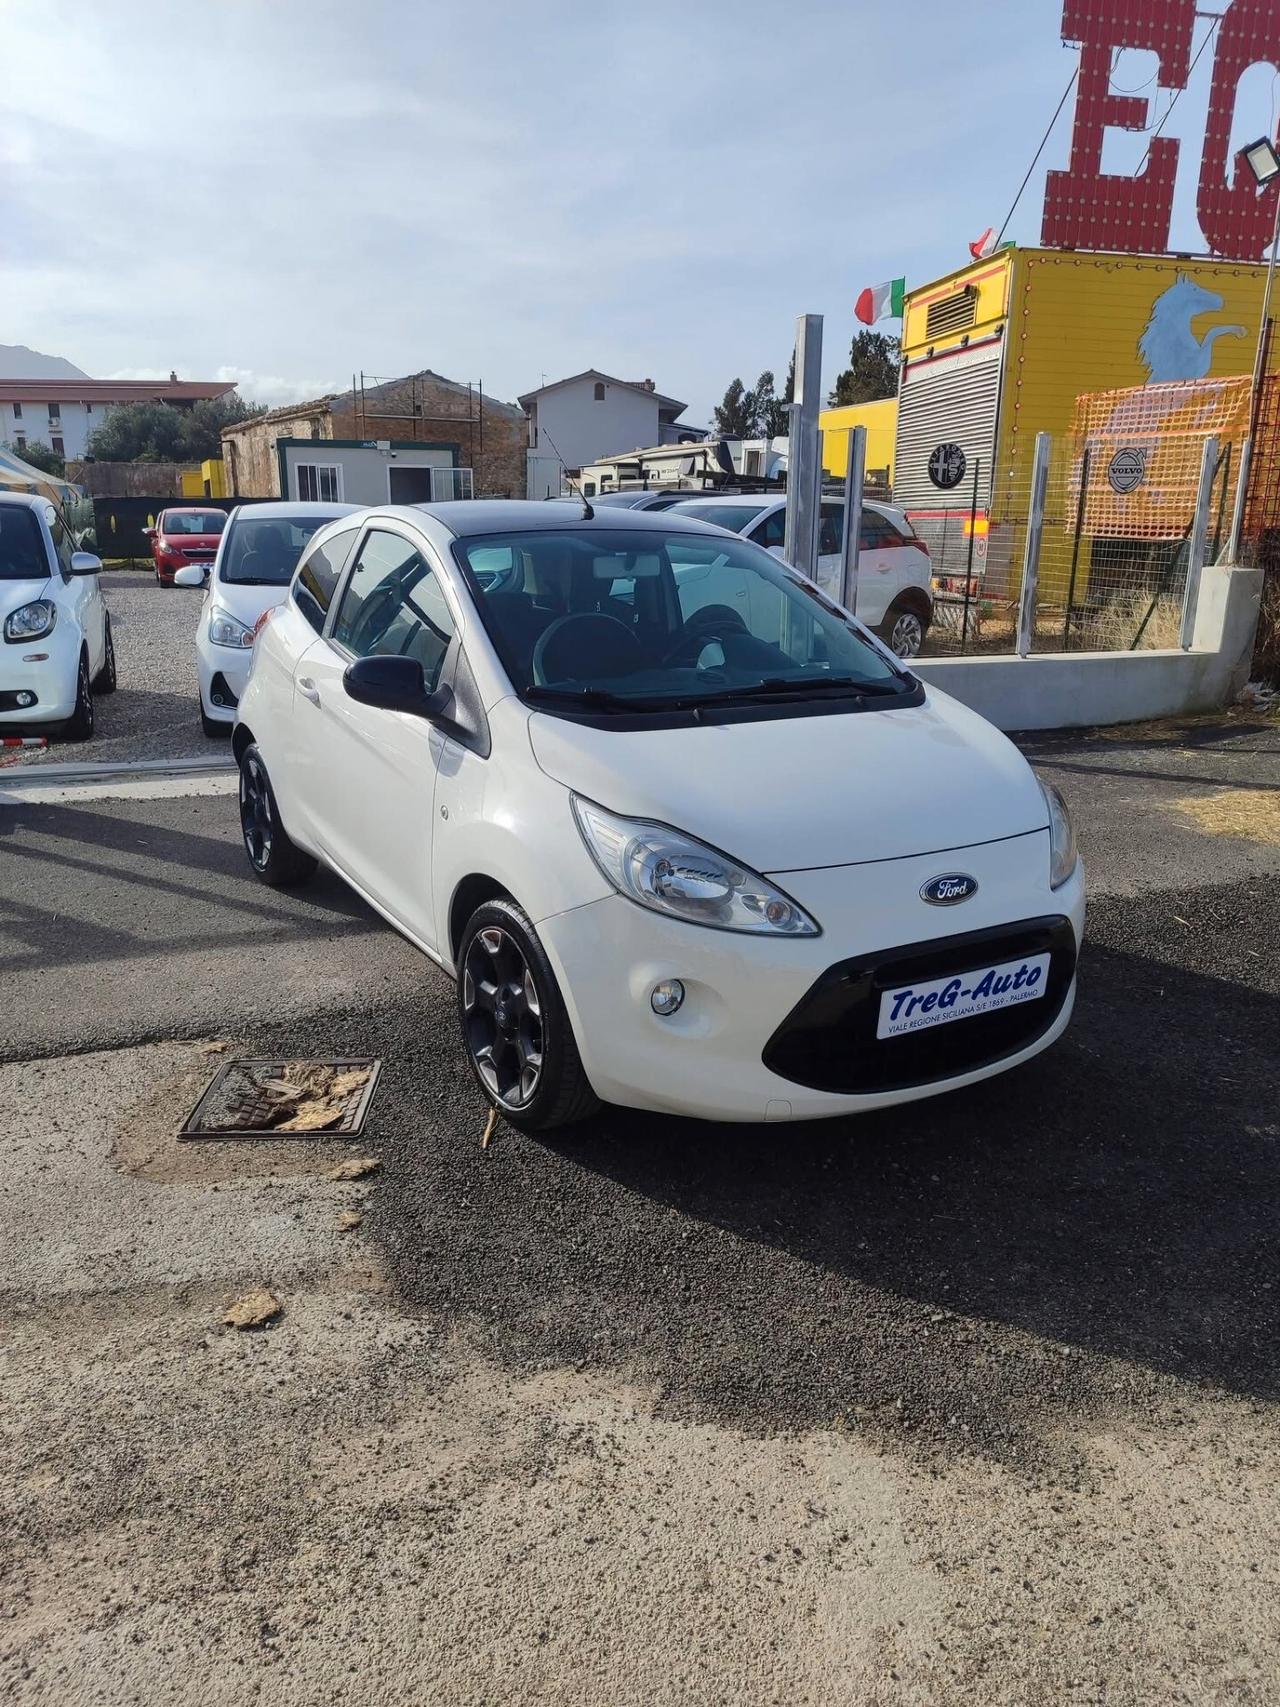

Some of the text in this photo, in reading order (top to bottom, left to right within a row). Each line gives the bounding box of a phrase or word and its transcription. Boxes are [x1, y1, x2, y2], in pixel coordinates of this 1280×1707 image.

[1111, 467, 1143, 475] VOLVO
[937, 878, 968, 899] Ford
[889, 964, 1042, 1021] TreG-Auto
[888, 1022, 907, 1033] VIALE
[909, 1014, 941, 1028] REGIONE
[942, 1006, 975, 1020] SICILIANA
[976, 1001, 987, 1011] S/E
[989, 998, 1005, 1009] 1869
[1009, 989, 1038, 1003] PALERMO
